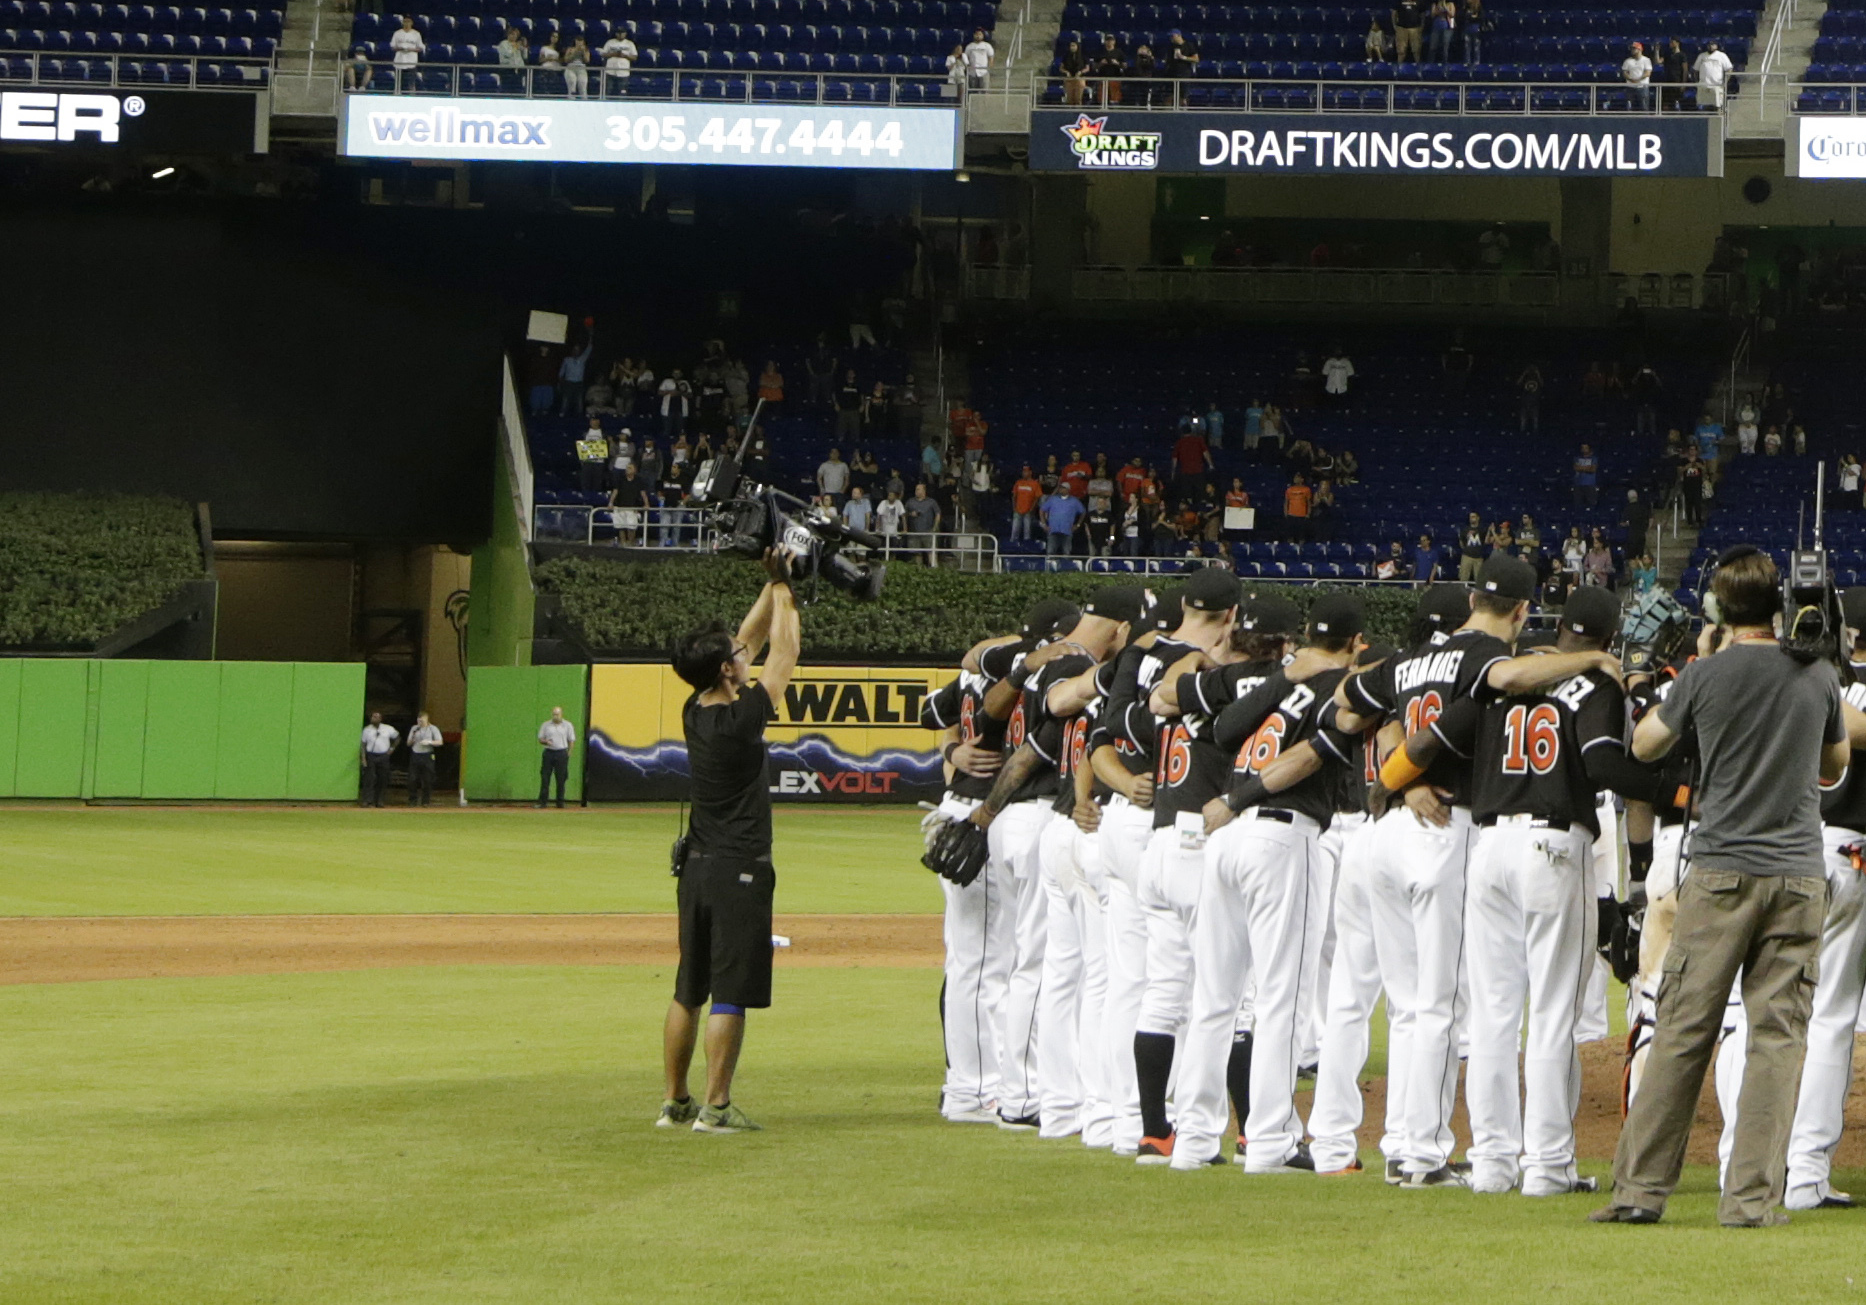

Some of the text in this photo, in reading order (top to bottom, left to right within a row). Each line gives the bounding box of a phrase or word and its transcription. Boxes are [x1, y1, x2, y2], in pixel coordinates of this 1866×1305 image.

[369, 107, 904, 158] wellmax 305.447.4444
[1076, 134, 1160, 152] DRAFT
[1199, 128, 1663, 171] DRAFTKINGS.COM/MLB
[1083, 150, 1156, 167] KINGS
[770, 683, 929, 724] WALT
[1156, 723, 1192, 790] 16
[1233, 711, 1288, 776] 16
[1501, 703, 1561, 775] 16
[769, 770, 899, 794] EXVOLT
